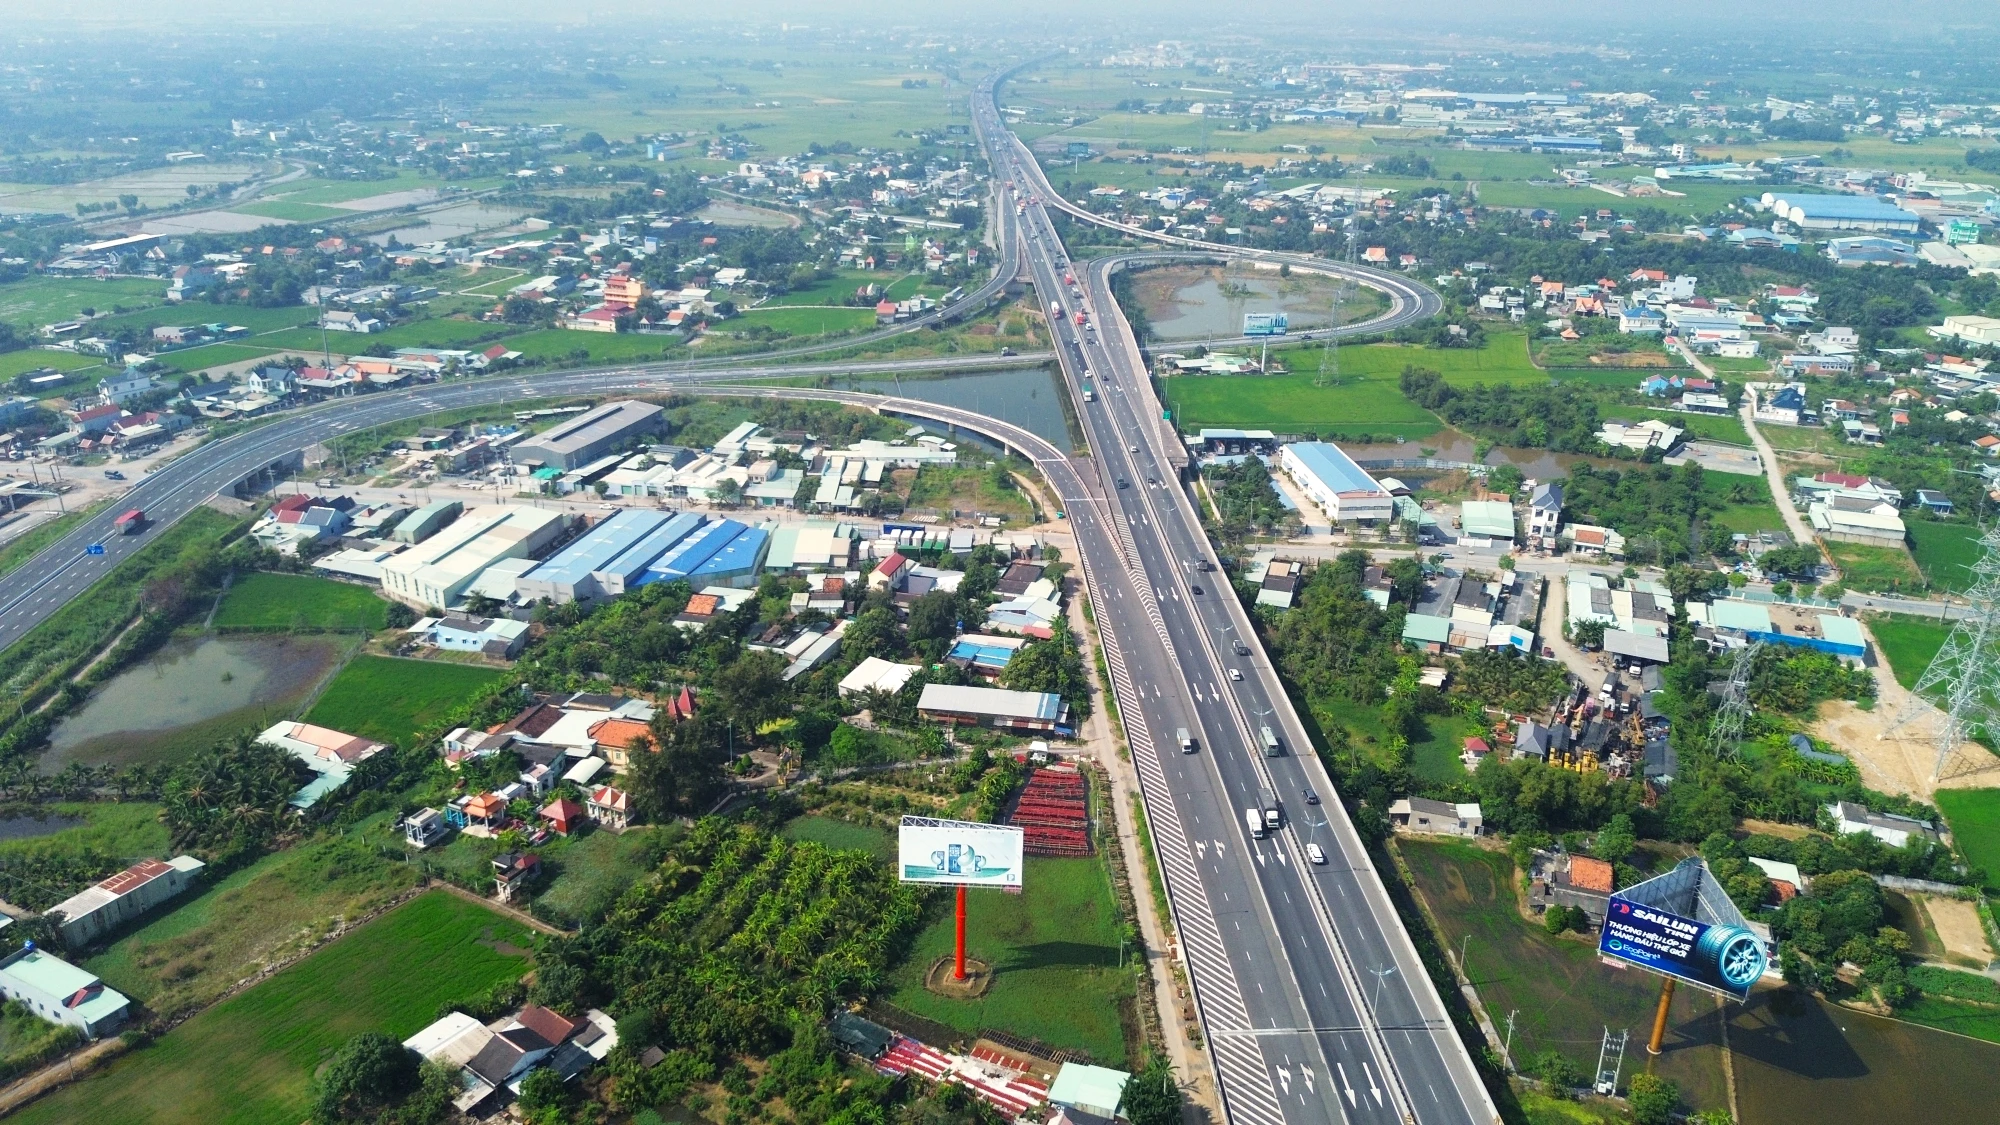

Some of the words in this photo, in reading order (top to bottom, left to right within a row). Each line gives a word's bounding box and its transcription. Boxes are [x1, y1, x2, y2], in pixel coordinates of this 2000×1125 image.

[1632, 909, 1698, 934] SAILUN
[1664, 927, 1693, 940] TIRE
[1679, 943, 1691, 951] XE
